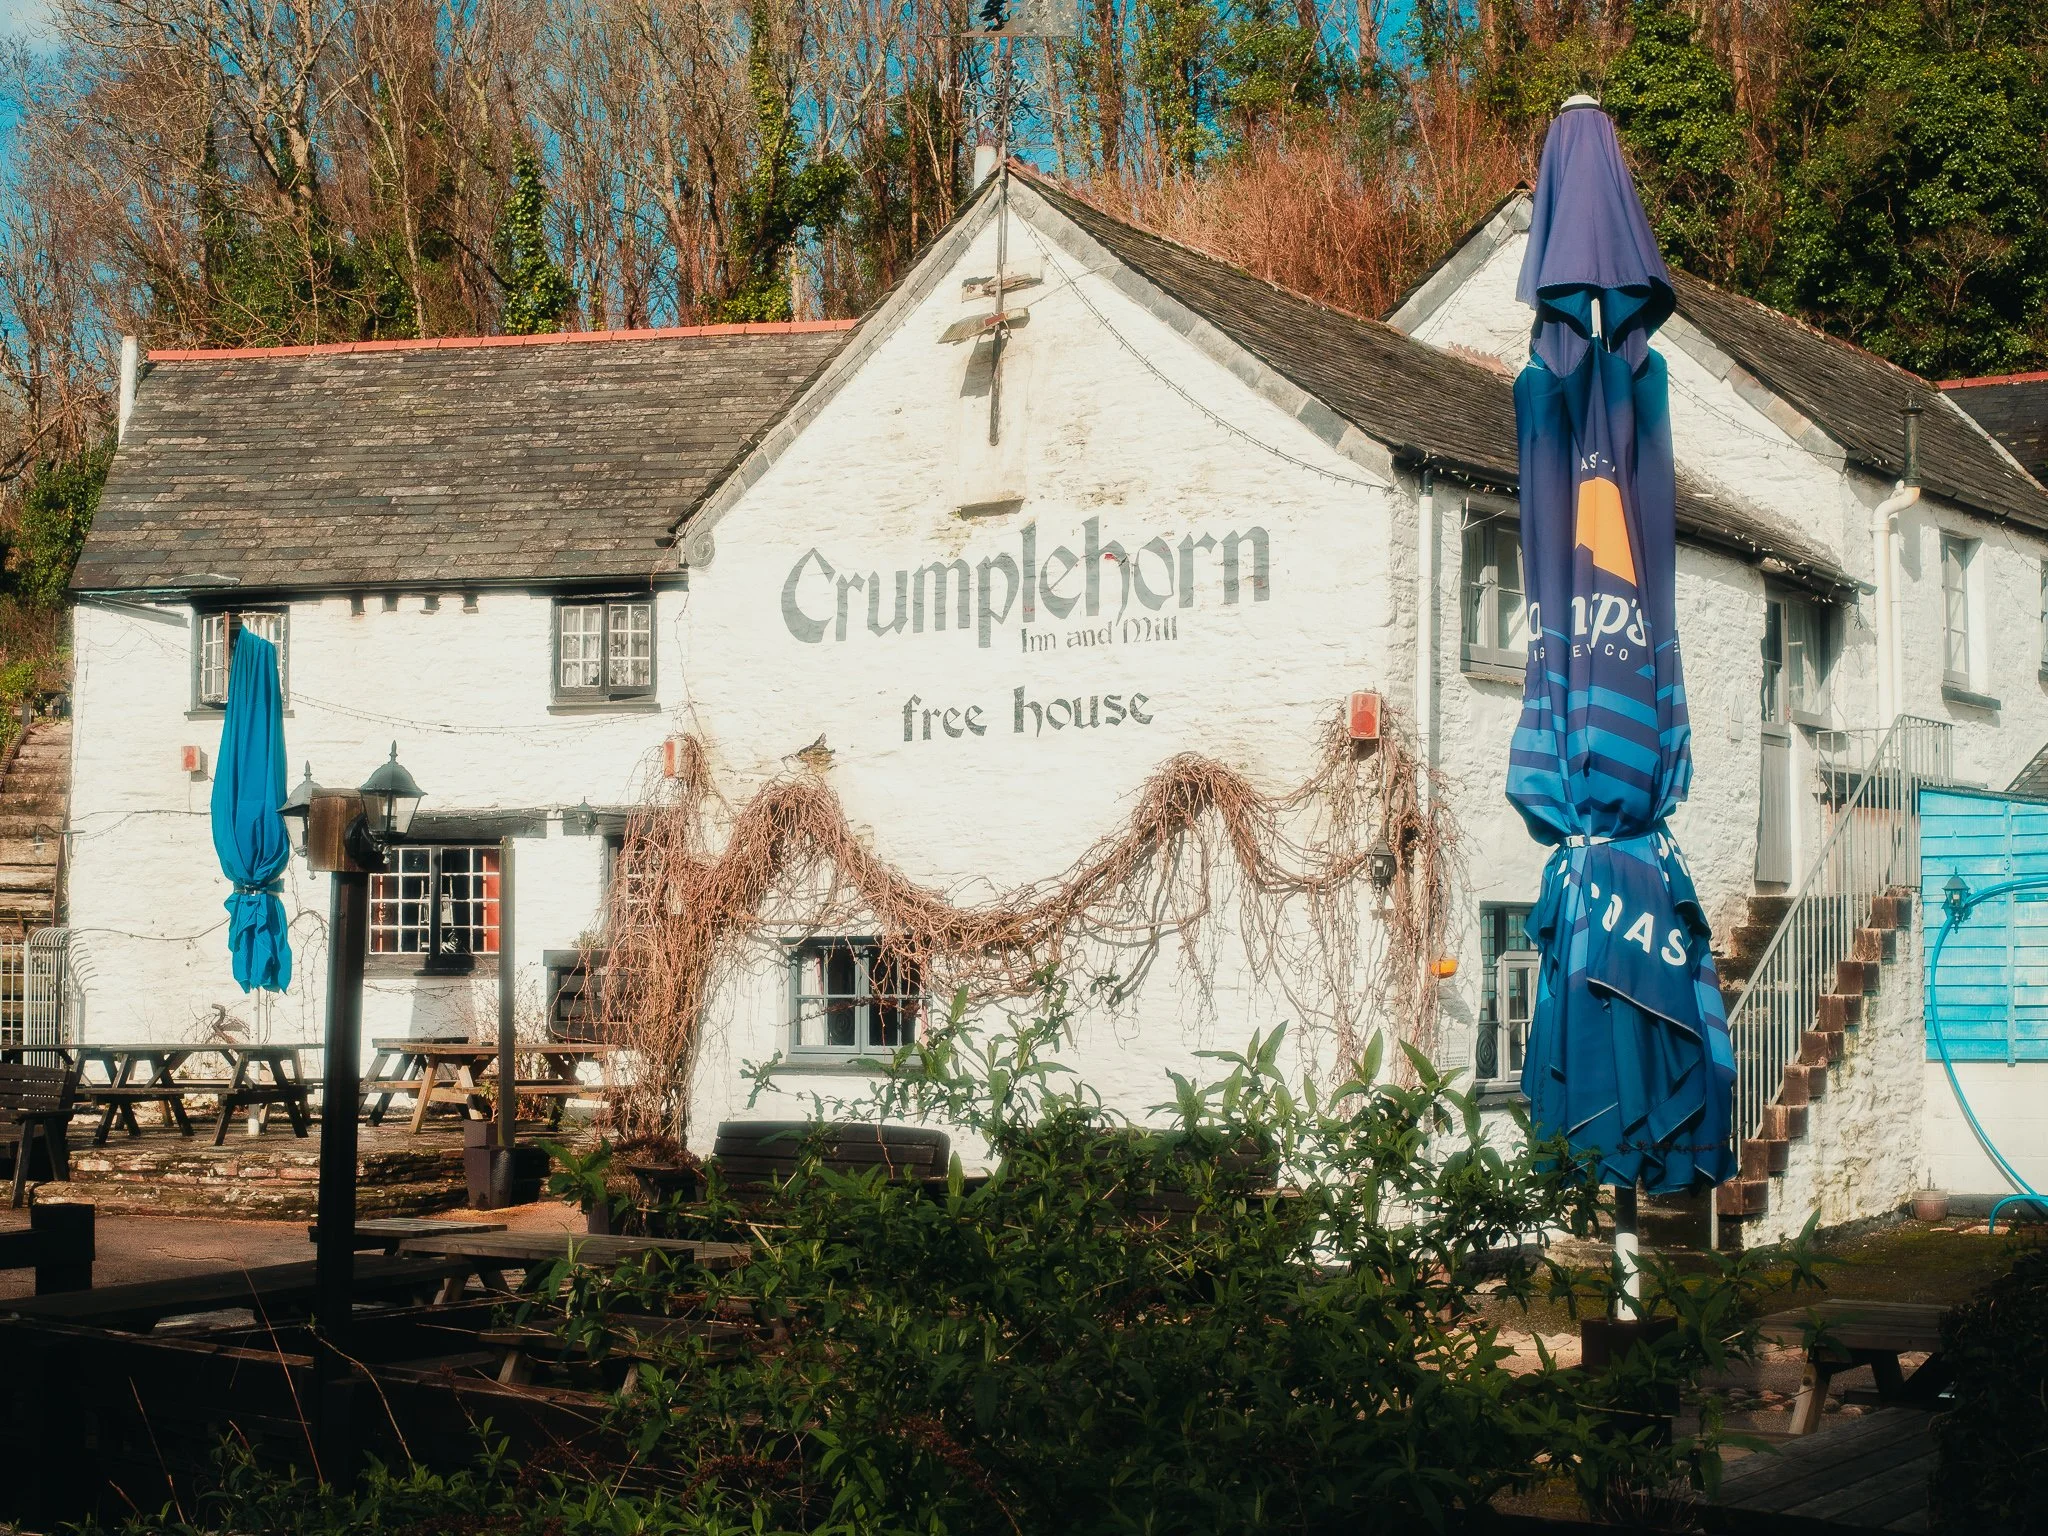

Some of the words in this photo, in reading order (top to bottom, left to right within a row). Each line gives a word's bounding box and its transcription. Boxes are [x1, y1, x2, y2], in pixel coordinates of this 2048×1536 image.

[781, 515, 1271, 648] Crumplehorn
[1021, 628, 1056, 653] Inn
[1066, 621, 1112, 648] and
[1123, 616, 1178, 643] Mill
[902, 694, 988, 742] free
[1013, 685, 1154, 738] house
